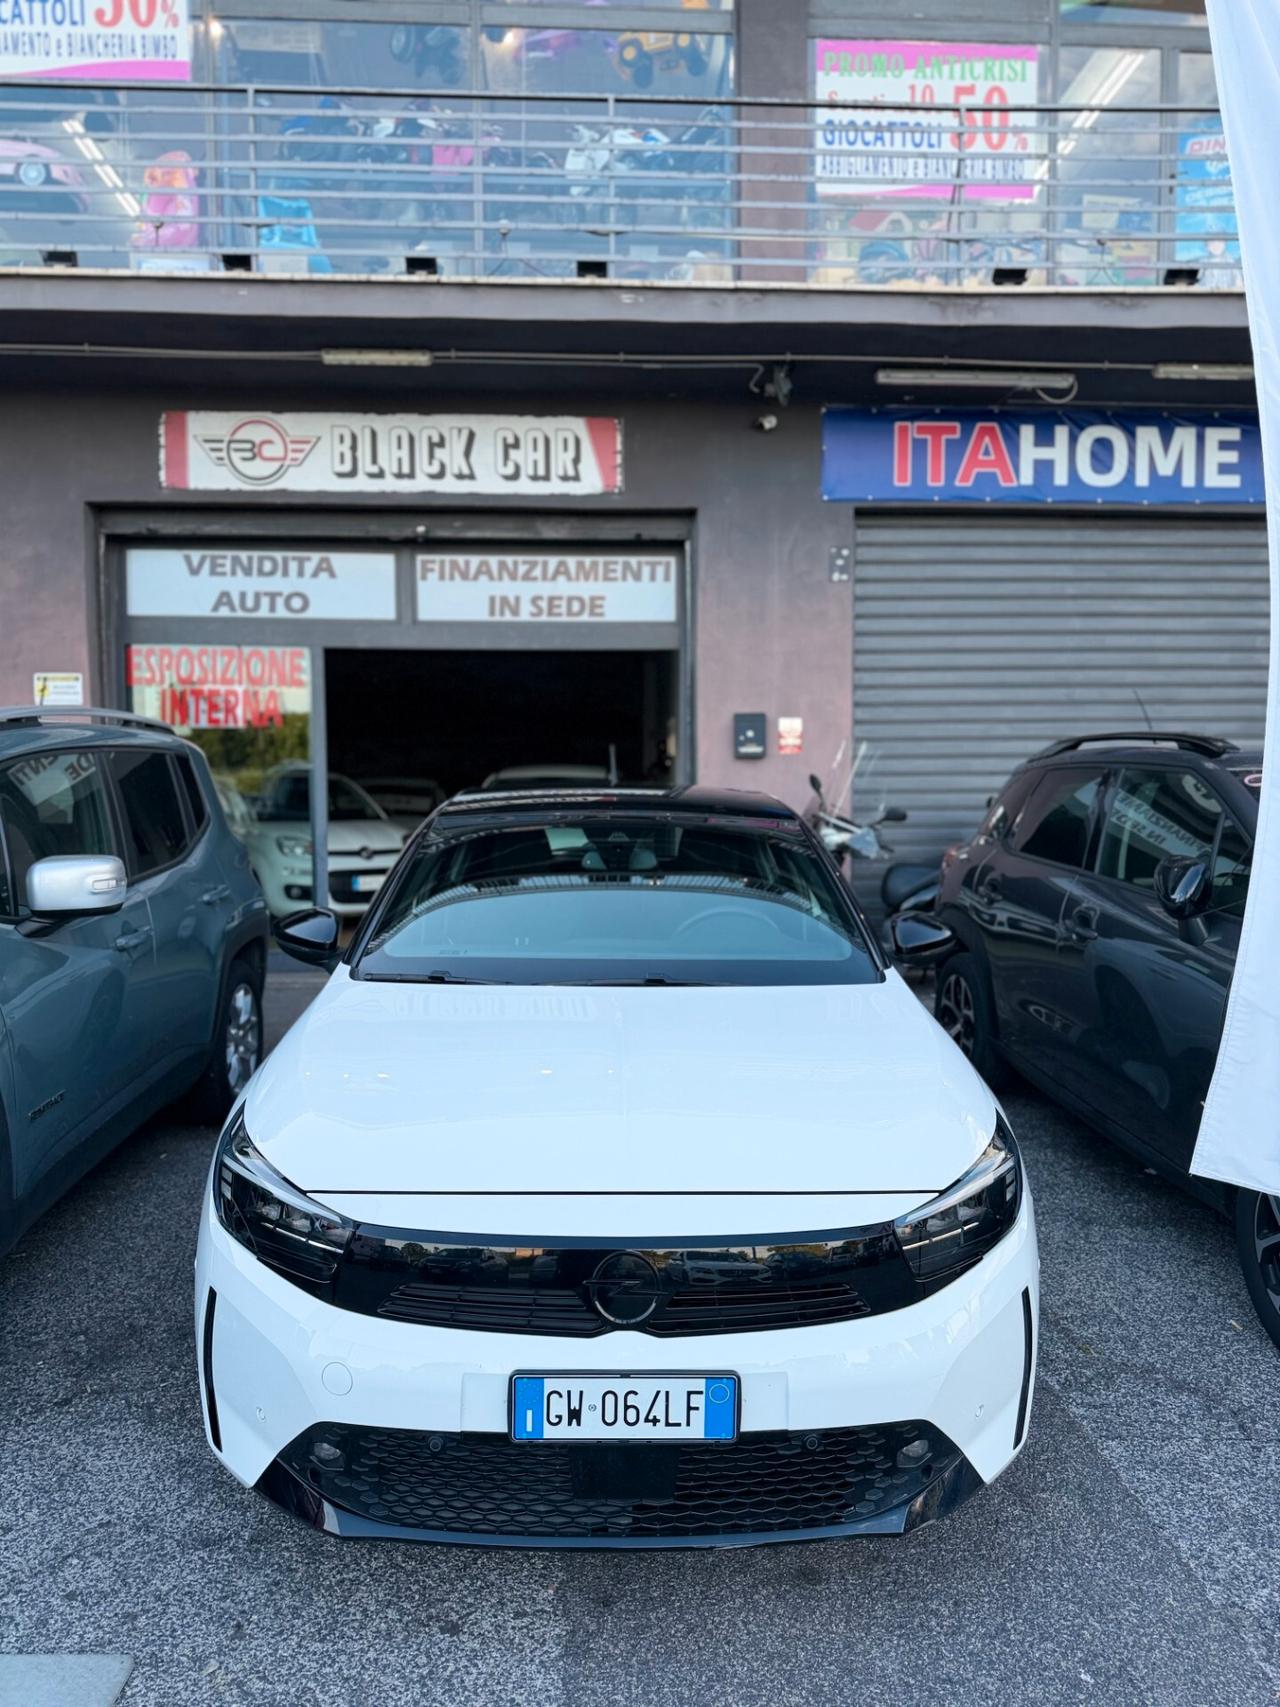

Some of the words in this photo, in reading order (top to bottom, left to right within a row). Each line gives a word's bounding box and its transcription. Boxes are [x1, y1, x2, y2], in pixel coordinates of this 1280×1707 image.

[141, 34, 177, 59] BIMBO
[823, 52, 905, 79] PROMO
[913, 56, 1027, 83] ANTICRISI
[822, 119, 943, 149] GIOCATTOLI
[330, 424, 477, 482] BLACK
[495, 426, 583, 483] CAR
[893, 421, 1241, 489] ITAHOME
[184, 554, 337, 579] VENDITA
[419, 558, 672, 583] FINANZIAMENTI
[210, 591, 310, 614] AUTO
[488, 595, 521, 617] IN
[529, 595, 606, 618] SEDE
[126, 645, 306, 688] ESPOSIZIONE
[160, 687, 284, 728] INTERNA
[546, 1390, 584, 1427] GW
[601, 1390, 704, 1427] 064LF
